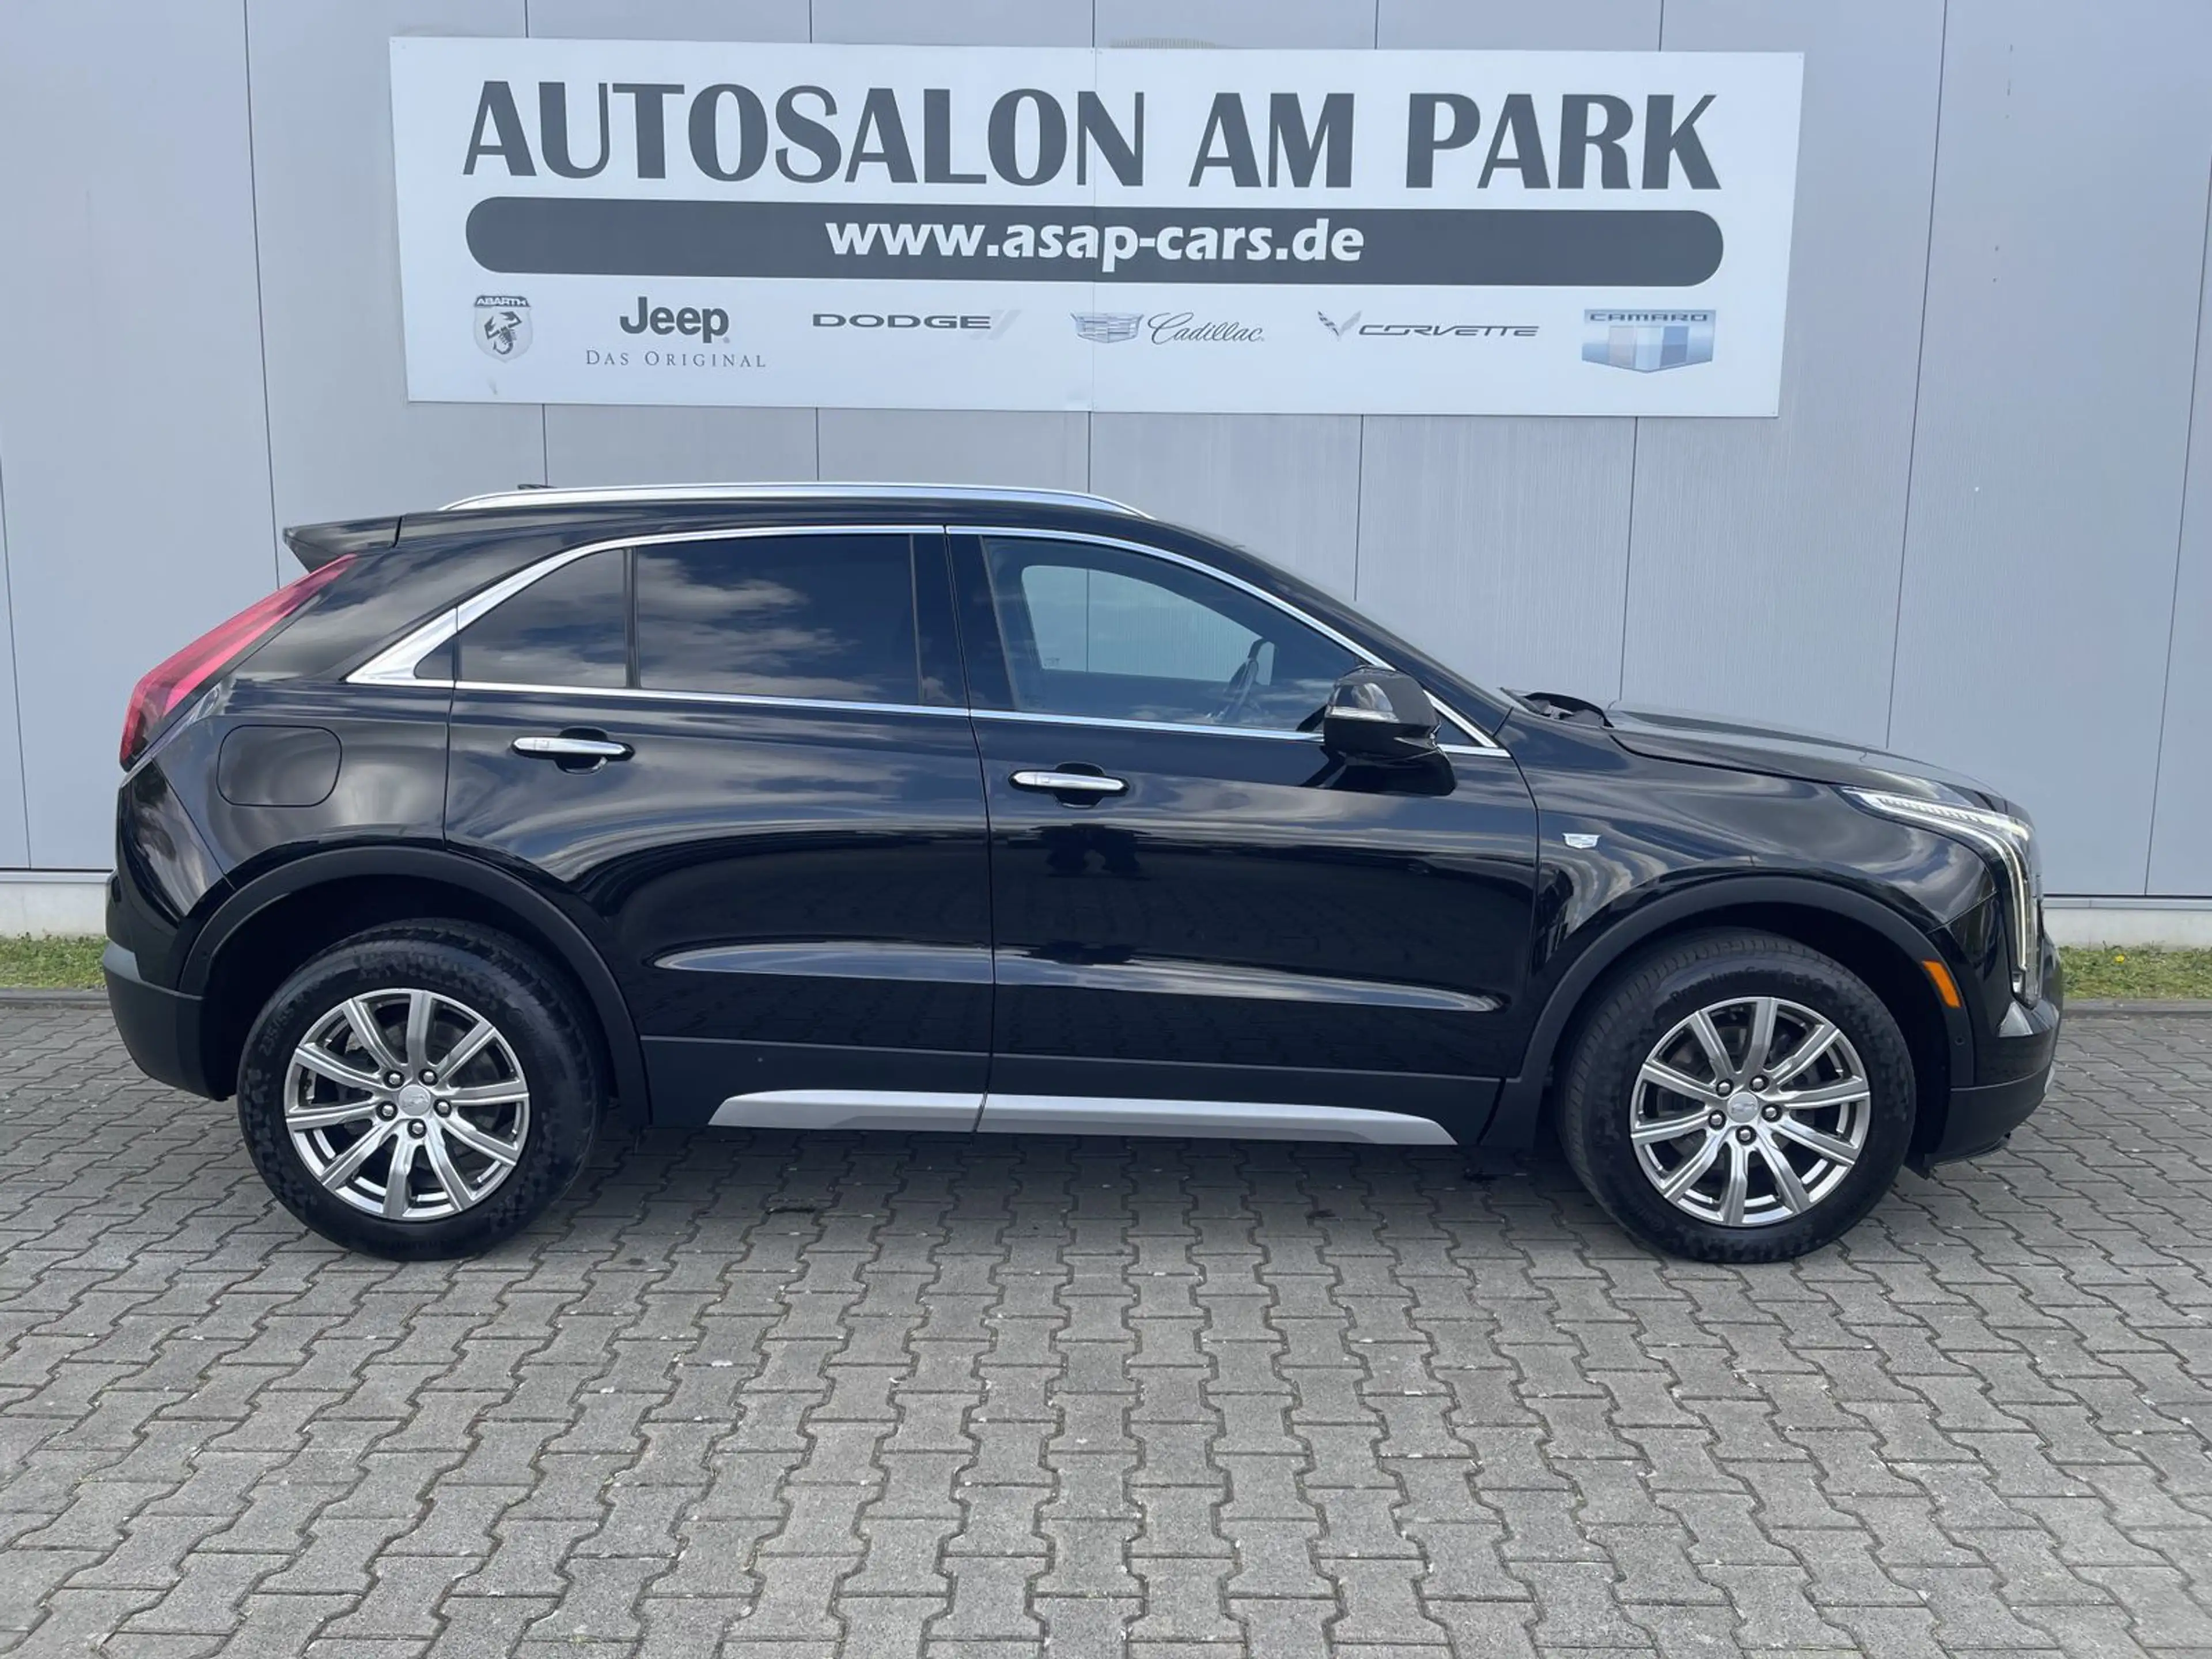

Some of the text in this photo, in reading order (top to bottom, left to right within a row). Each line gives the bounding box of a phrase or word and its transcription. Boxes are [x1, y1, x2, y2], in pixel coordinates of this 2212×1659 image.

[463, 81, 1721, 190] AUTOSALON AM PARK
[825, 218, 1364, 272] www.asap-cars.de
[476, 297, 527, 306] ABARTH
[620, 297, 729, 343] Jeep
[813, 313, 991, 329] DODGE
[1147, 312, 1262, 345] Cadillac
[1590, 313, 1707, 321] CAMARO
[1359, 325, 1540, 336] CORVETTE
